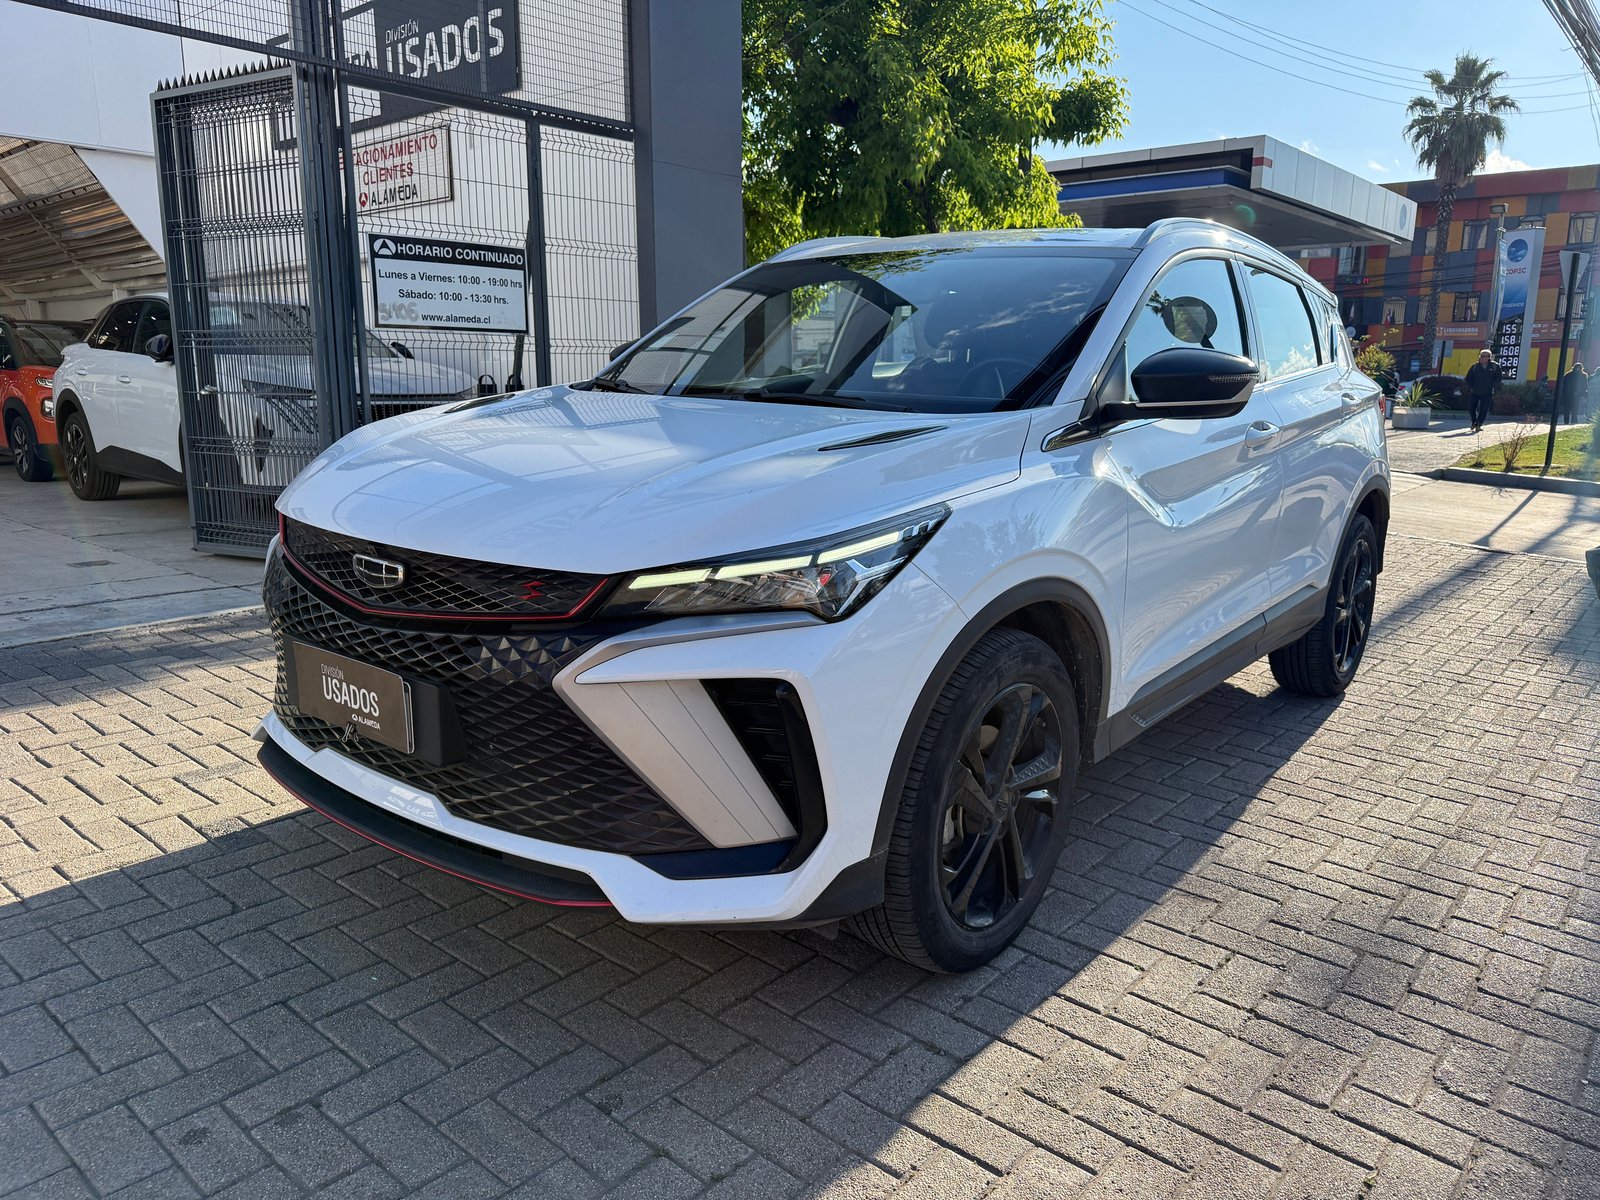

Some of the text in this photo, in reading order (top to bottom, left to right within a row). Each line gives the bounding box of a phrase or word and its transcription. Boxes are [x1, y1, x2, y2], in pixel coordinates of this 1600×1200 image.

[385, 8, 505, 79] USADOS
[363, 161, 414, 186] CLIENTES
[371, 183, 419, 206] ALAMEDA
[397, 243, 524, 266] HORARIO CONTINUADO
[378, 269, 408, 280] Lunes
[410, 273, 417, 281] a
[418, 271, 456, 284] Viernes:
[458, 275, 481, 285] 10:00
[487, 277, 509, 288] 19:00
[398, 288, 437, 301] Sábado:
[439, 291, 463, 302] 10:00
[470, 293, 492, 304] 13:30
[493, 295, 509, 305] hrs.
[421, 314, 491, 325] www.alameda.cl
[322, 674, 380, 718] USADOS
[358, 715, 381, 731] ALAMEDA
